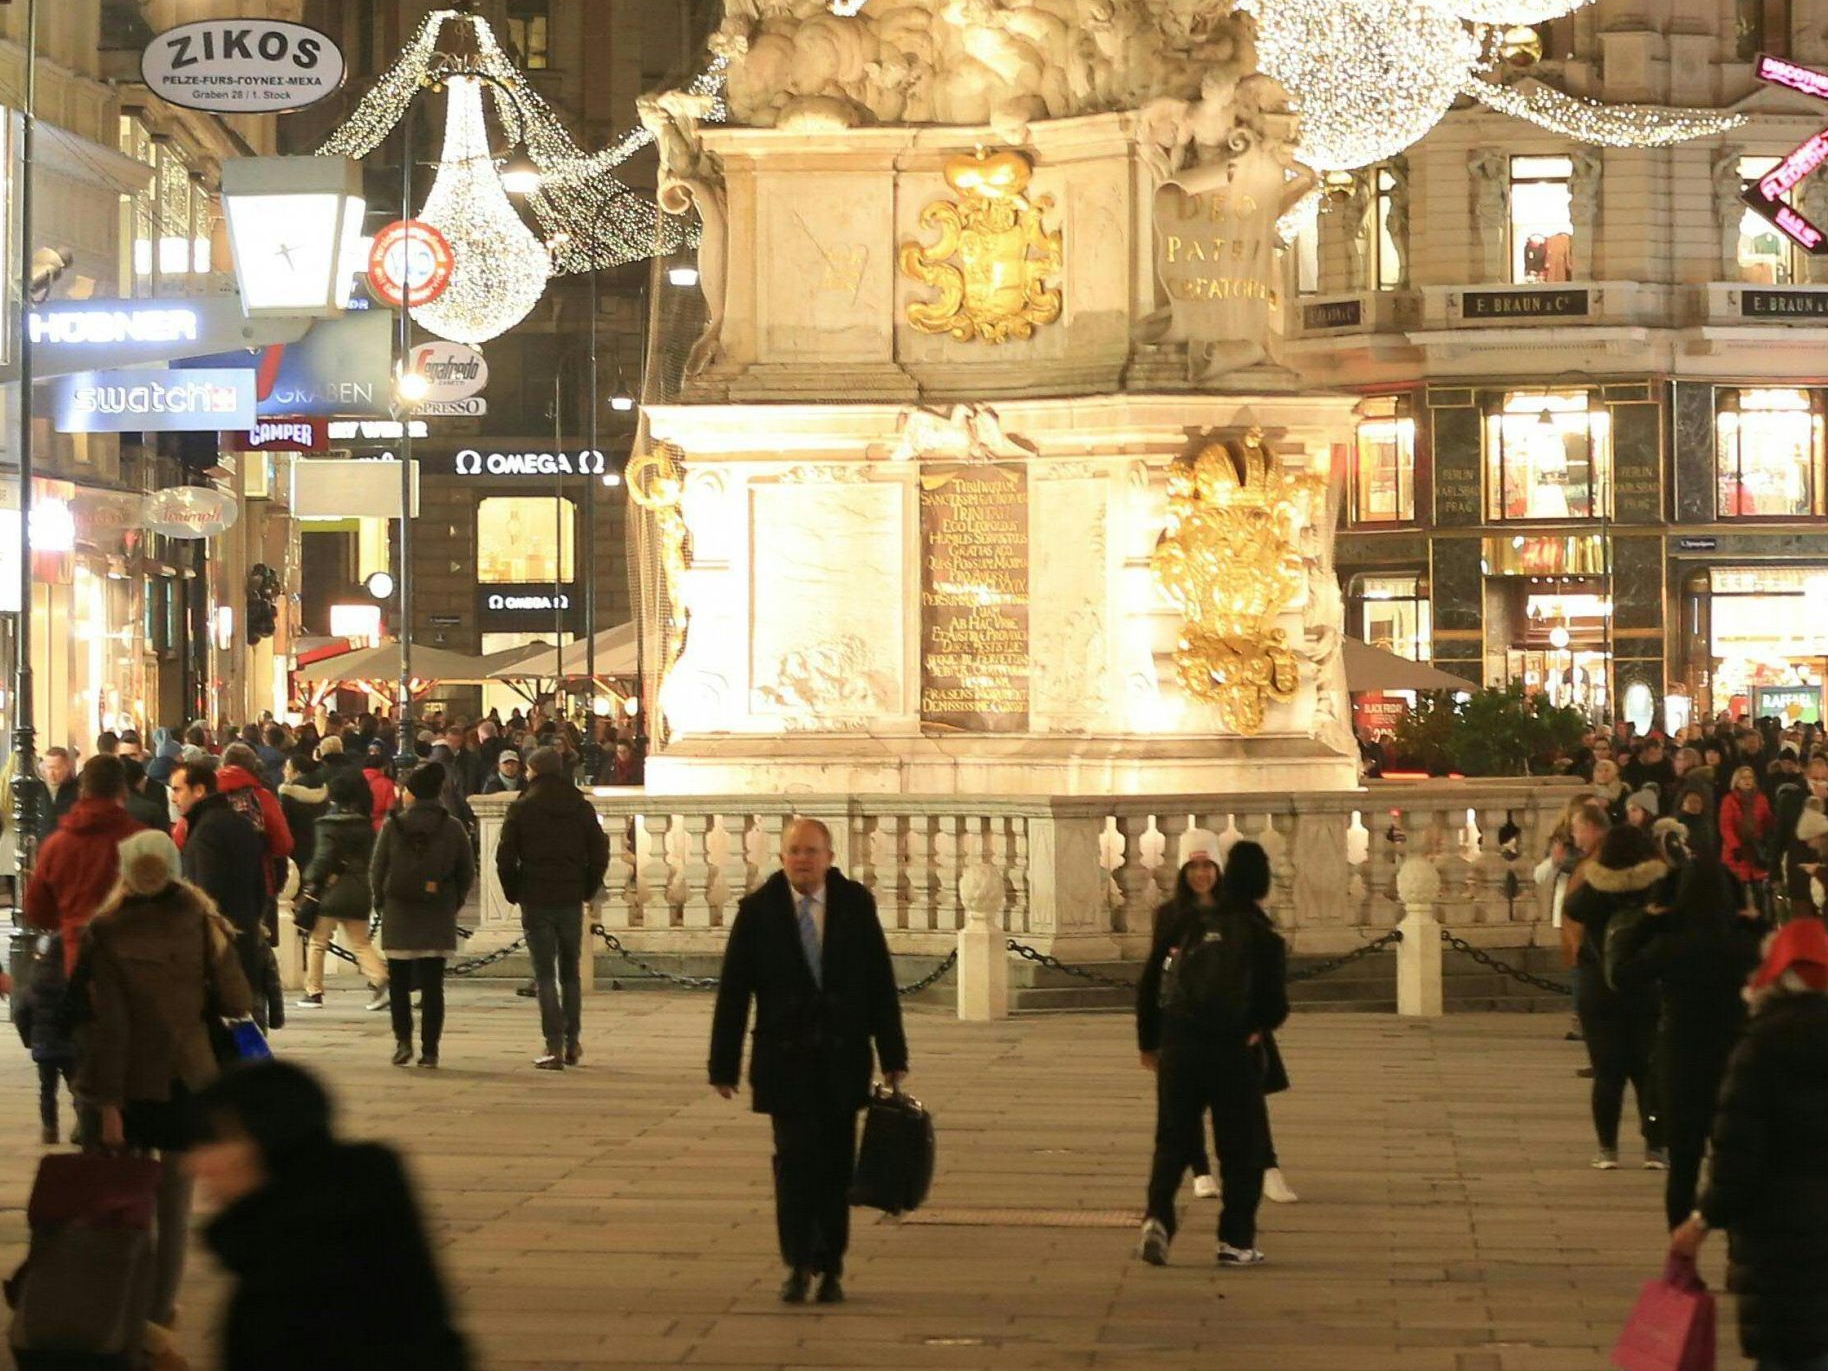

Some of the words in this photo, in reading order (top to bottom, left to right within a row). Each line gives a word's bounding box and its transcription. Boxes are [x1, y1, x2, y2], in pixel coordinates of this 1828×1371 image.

[167, 30, 321, 70] ZIKOS
[192, 90, 229, 100] Graben
[232, 90, 244, 100] 28
[264, 90, 292, 100] Stock
[1494, 296, 1541, 312] BRAUN
[1769, 296, 1814, 312] BRAUN
[74, 383, 213, 414] swatch
[249, 423, 312, 447] CAMPER
[486, 453, 574, 475] OMEGA
[505, 596, 551, 610] OMEGA
